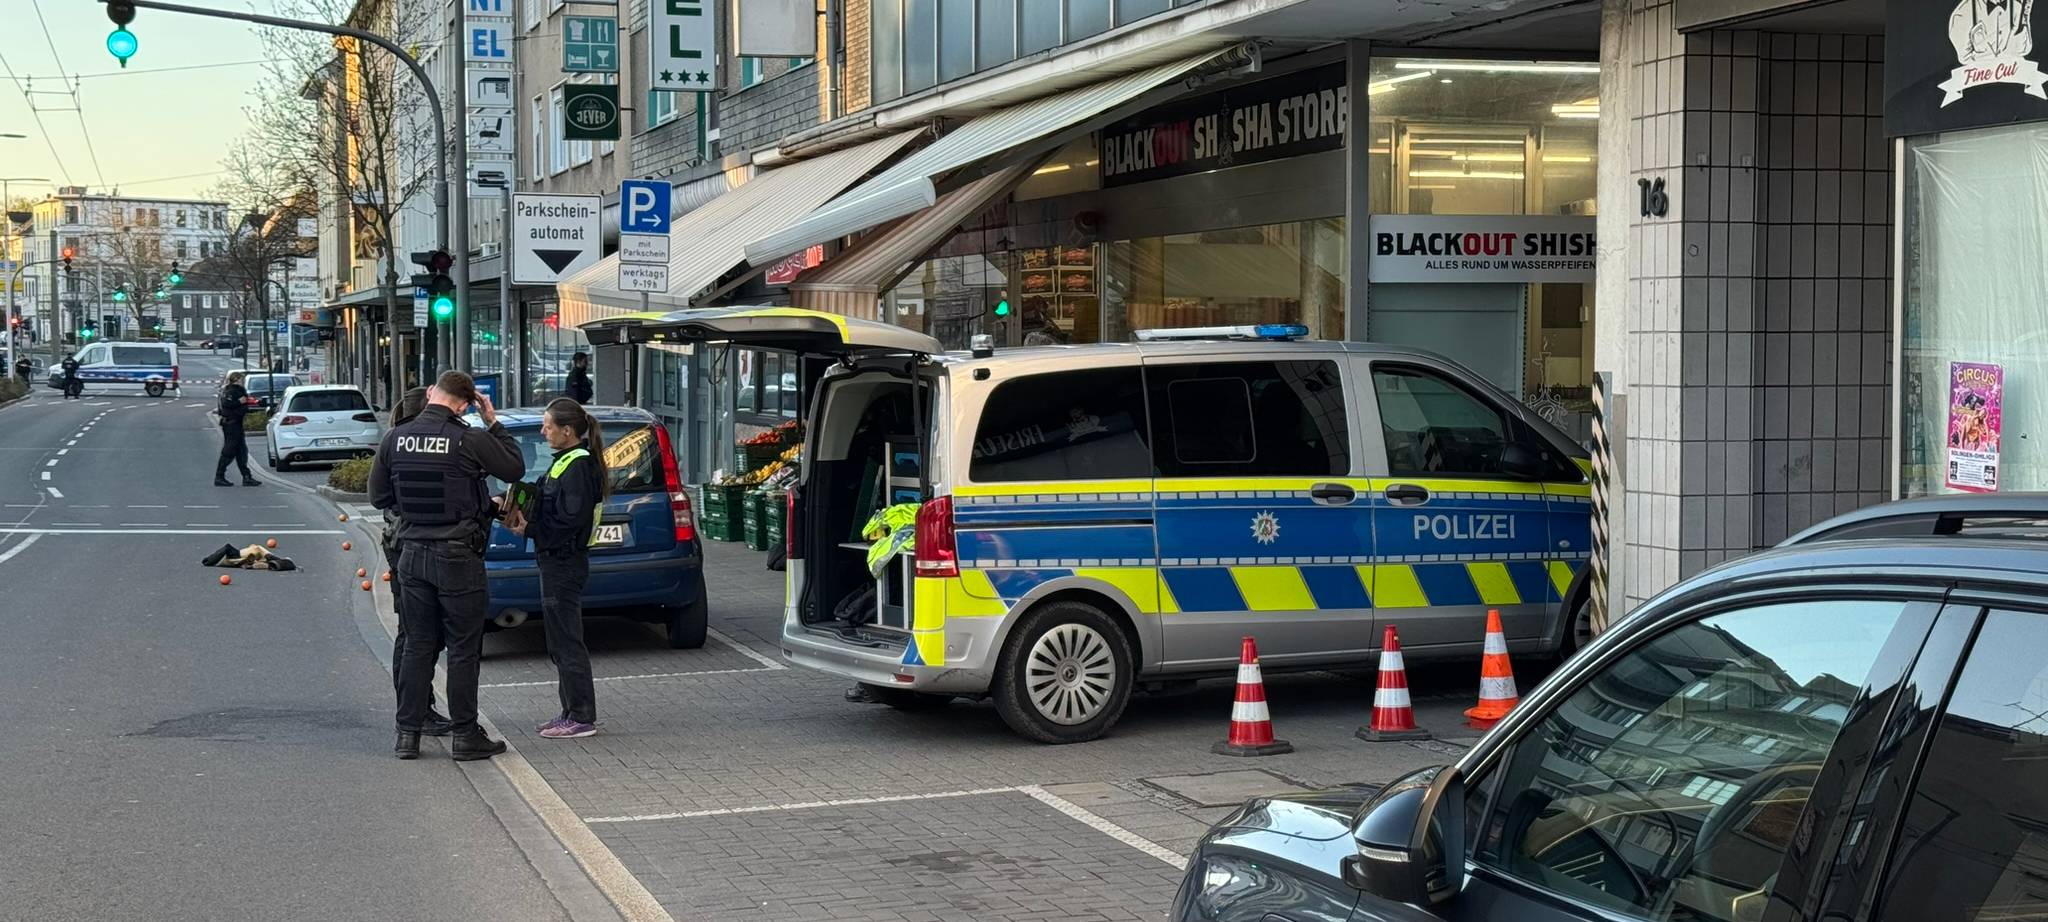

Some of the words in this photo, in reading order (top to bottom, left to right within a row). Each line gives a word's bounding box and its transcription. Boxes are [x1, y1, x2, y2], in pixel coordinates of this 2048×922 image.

[472, 29, 505, 57] EL
[1964, 67, 1993, 86] Fine
[1995, 61, 2018, 81] Cut
[576, 110, 607, 125] JEVER
[1104, 119, 1191, 177] BLACKOUT
[1277, 86, 1347, 145] STORE
[629, 187, 656, 226] P
[1637, 177, 1668, 218] 16
[517, 201, 597, 218] Parkschein-
[530, 226, 585, 241] automat
[623, 248, 666, 258] Parkschein
[638, 240, 651, 248] mit
[1376, 232, 1518, 256] BLACKOUT
[622, 269, 665, 279] werktags
[1425, 260, 1458, 270] ALLES
[1461, 260, 1491, 270] RUND
[1493, 260, 1509, 270] UM
[1511, 260, 1596, 270] WASSERPFEIFEN
[1956, 368, 1996, 386] CIRCUS
[396, 436, 450, 454] POLIZEI
[1413, 514, 1516, 540] POLIZEI
